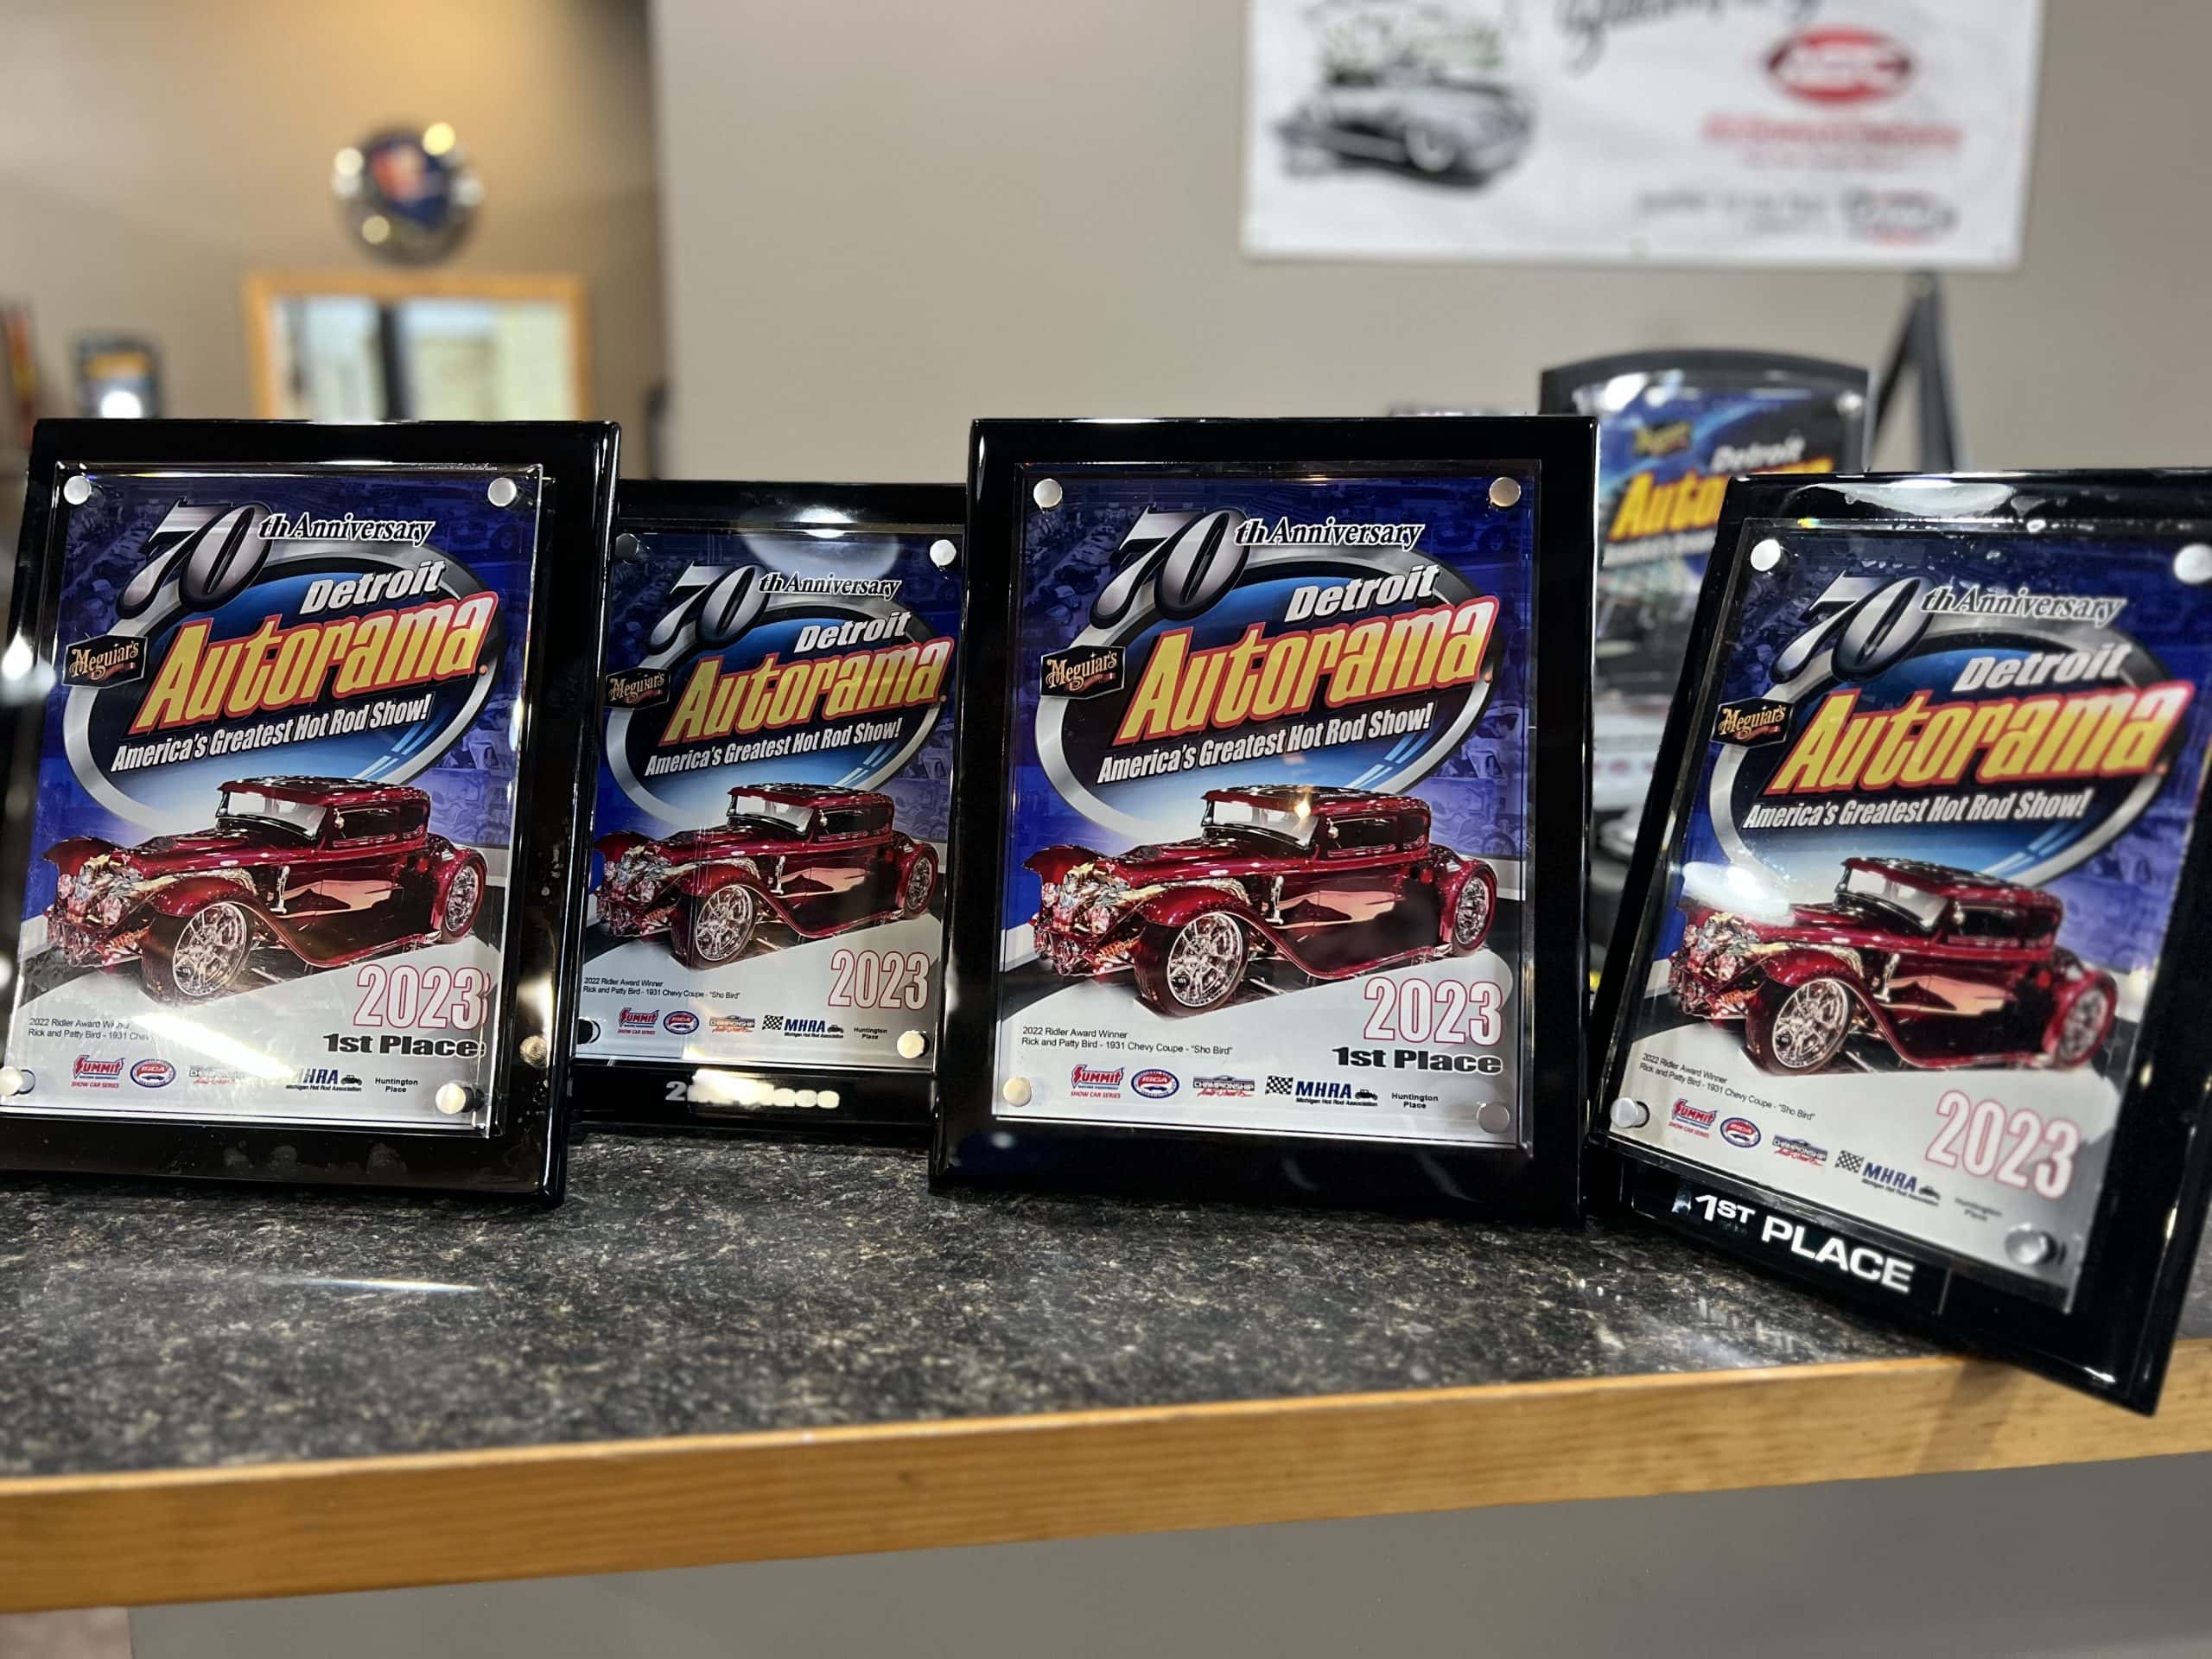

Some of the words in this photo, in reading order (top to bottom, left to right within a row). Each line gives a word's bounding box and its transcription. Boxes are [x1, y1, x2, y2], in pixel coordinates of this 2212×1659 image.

[299, 560, 446, 615] Detroit
[1284, 564, 1441, 624] Detroit
[793, 612, 912, 653] Detroit
[69, 640, 139, 680] Meguiar's
[129, 591, 499, 734] Autorama
[1046, 651, 1117, 691] Meguiar's
[1114, 594, 1500, 746] Autorama
[1953, 642, 2131, 691] Detroit
[609, 672, 664, 702] Meguiar's
[659, 636, 954, 747] Autorama
[111, 734, 208, 772] America's
[209, 720, 293, 755] Greatest
[293, 714, 331, 741] Hot
[330, 706, 368, 734] Rod
[370, 693, 432, 728] Show!
[1721, 703, 1787, 741] Meguiar's
[1764, 679, 2195, 795] Autorama
[645, 747, 720, 776] America's
[724, 740, 788, 765] Greatest
[791, 733, 819, 753] Hot
[819, 726, 849, 748] Rod
[854, 718, 903, 743] Show!
[1097, 742, 1197, 784] America's
[1198, 728, 1287, 766] Greatest
[1287, 722, 1327, 753] Hot
[1328, 715, 1367, 744] Rod
[1370, 702, 1434, 737] Show!
[1742, 801, 1838, 830] America's
[1839, 798, 1929, 825] Greatest
[1928, 795, 1974, 822] Hot
[1975, 793, 2017, 820] Rod
[2014, 788, 2094, 819] Show!
[353, 964, 485, 1030] 2023
[611, 987, 626, 995] Patty
[828, 949, 930, 1010] 2023
[75, 1020, 101, 1028] Award
[785, 1019, 825, 1033] MHRA
[1363, 976, 1503, 1046] 2023
[29, 1028, 45, 1037] Rick
[64, 1029, 83, 1039] Patty
[86, 1030, 101, 1039] Bird
[108, 1031, 127, 1040] 1931
[323, 1033, 373, 1053] 1st
[379, 1035, 482, 1058] Place
[1021, 1037, 1039, 1046] Rick
[1058, 1039, 1079, 1049] Patty
[1082, 1039, 1097, 1048] Bird
[1105, 1040, 1125, 1049] 1931
[1128, 1042, 1154, 1053] Chevy
[1156, 1044, 1184, 1053] Coupe
[1022, 1027, 1043, 1035] 2022
[1045, 1027, 1068, 1036] Ridler
[1071, 1028, 1096, 1037] Award
[1098, 1030, 1128, 1039] Winner
[294, 1068, 339, 1084] HRA
[1071, 1065, 1124, 1089] SUMMIT
[1332, 1046, 1386, 1067] 1st
[1395, 1049, 1502, 1074] Place
[1643, 1053, 1660, 1065] 2022
[1660, 1058, 1679, 1070] Ridler
[1680, 1064, 1702, 1077] Award
[1703, 1071, 1727, 1084] Winner
[375, 1077, 418, 1086] Huntington
[1296, 1081, 1351, 1098] MHRA
[1392, 1092, 1439, 1103] Huntington
[1640, 1062, 1653, 1073] Rick
[1656, 1067, 1668, 1077] and
[1669, 1071, 1685, 1084] Patty
[1687, 1077, 1700, 1087] Bird
[1707, 1083, 1722, 1094] 1931
[1725, 1088, 1746, 1103] Chevy
[1749, 1096, 1771, 1109] Coupe
[1924, 1090, 2080, 1200] 2023
[1862, 1162, 1917, 1192] MHRA
[1695, 1194, 1755, 1222] 1ST
[1762, 1215, 1914, 1294] PLACE
